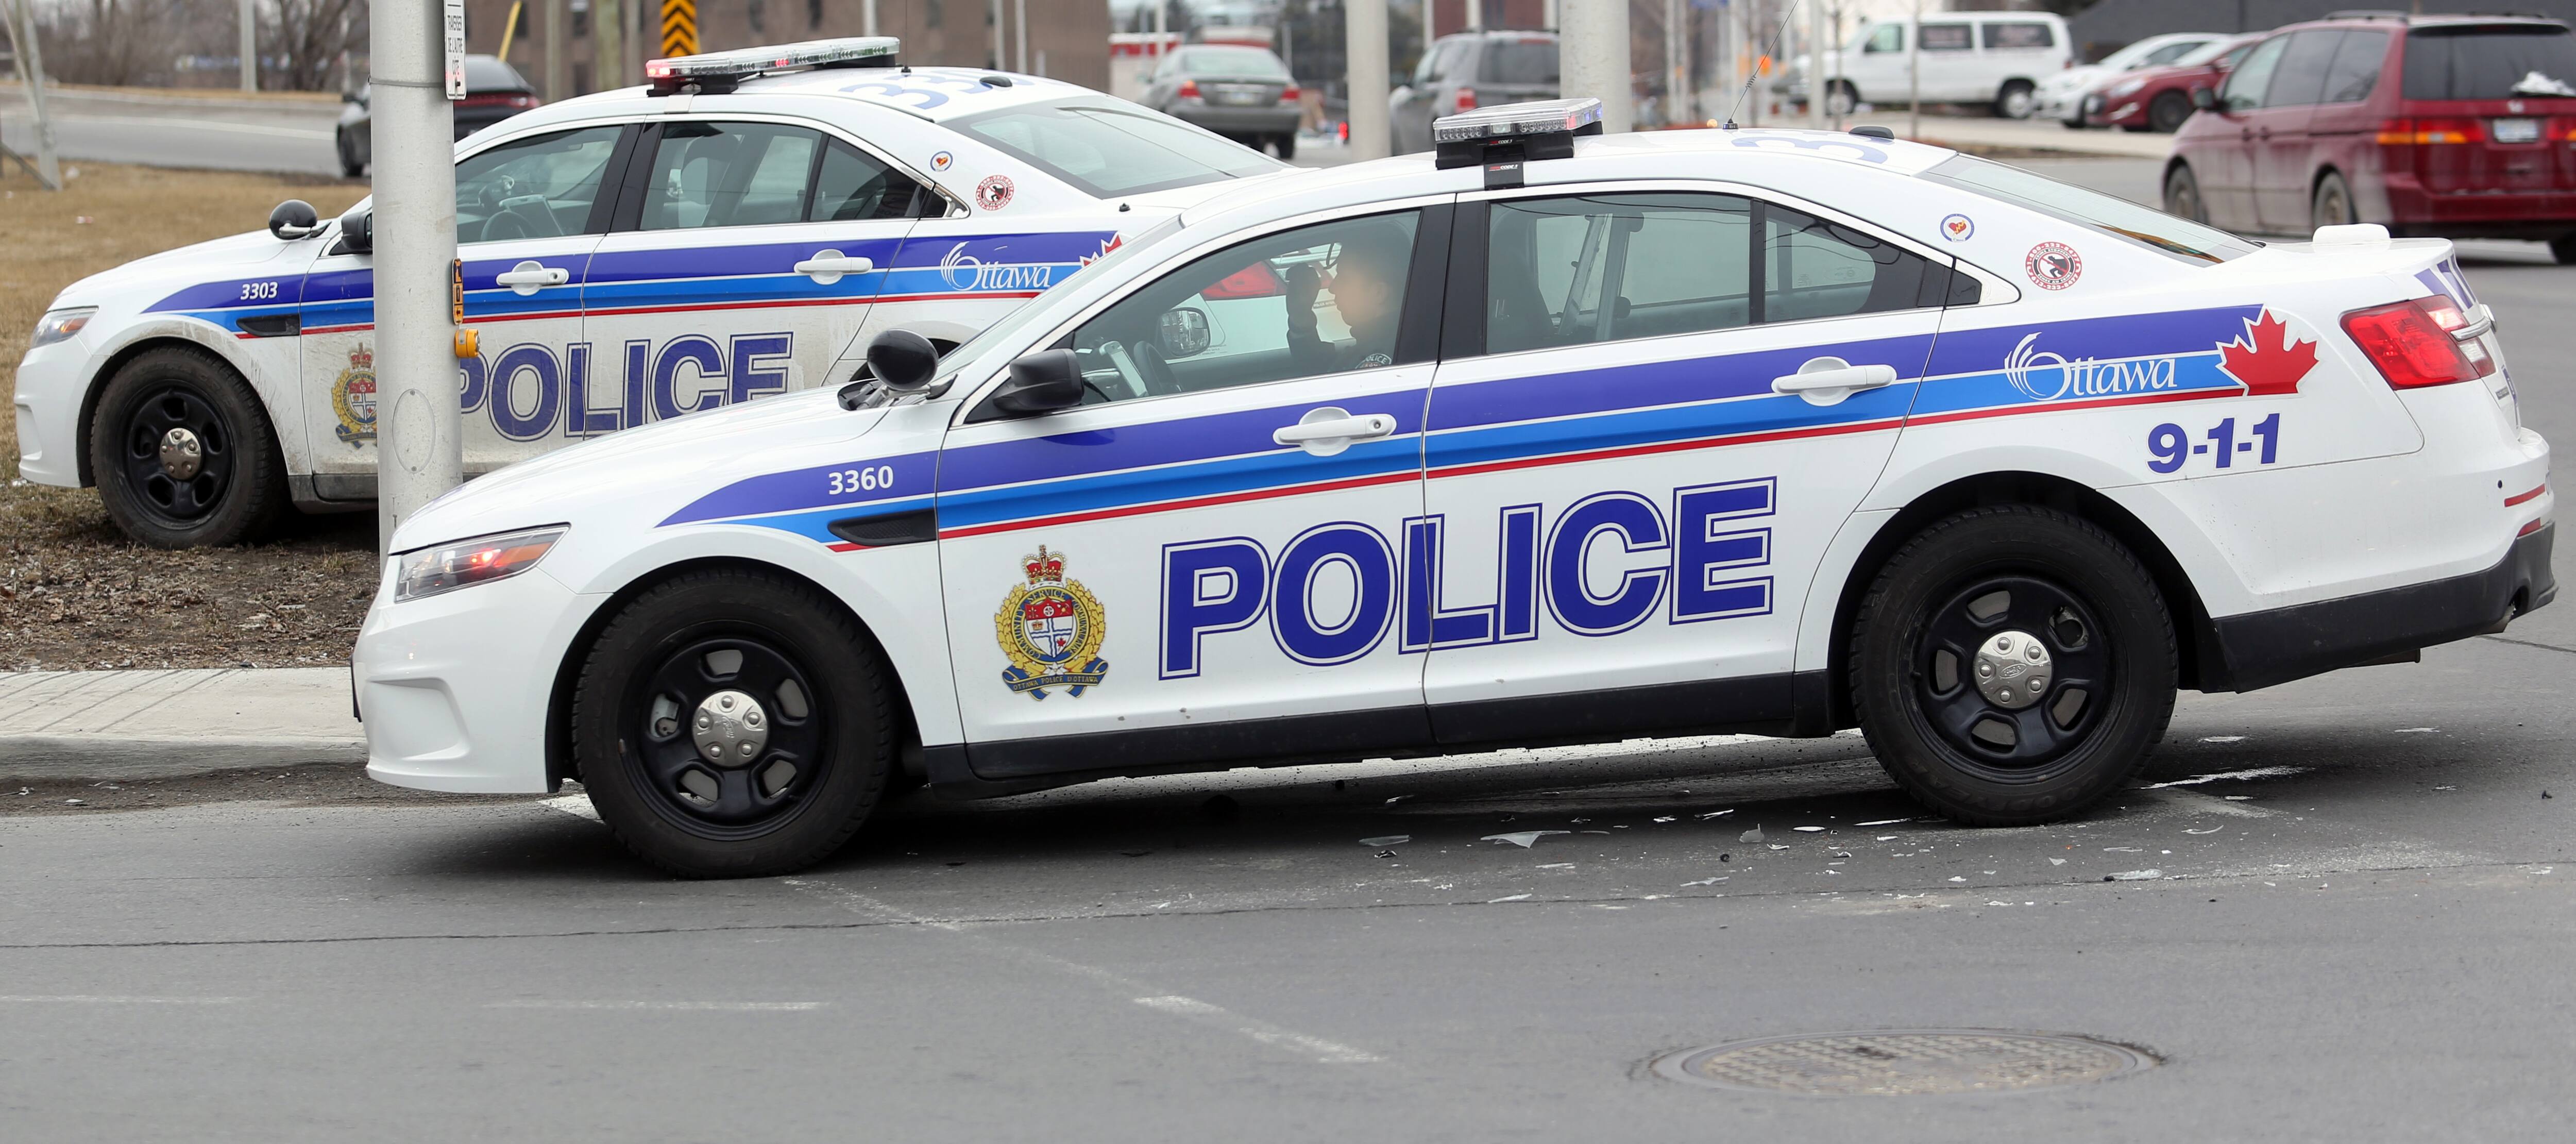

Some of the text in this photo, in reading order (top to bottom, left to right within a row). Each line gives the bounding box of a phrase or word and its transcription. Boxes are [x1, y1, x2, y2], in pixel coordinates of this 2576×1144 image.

[940, 241, 1052, 291] Ottawa
[240, 281, 278, 300] 3303
[1365, 355, 1387, 364] OLICE
[2005, 332, 2177, 400] Ottawa
[2147, 413, 2280, 474] 9-1-1
[828, 465, 894, 495] 3360
[1159, 476, 1777, 681] POLICE
[1028, 589, 1065, 602] SERVICE
[1013, 680, 1039, 691] OTTAWA
[1041, 676, 1064, 684] POLICE
